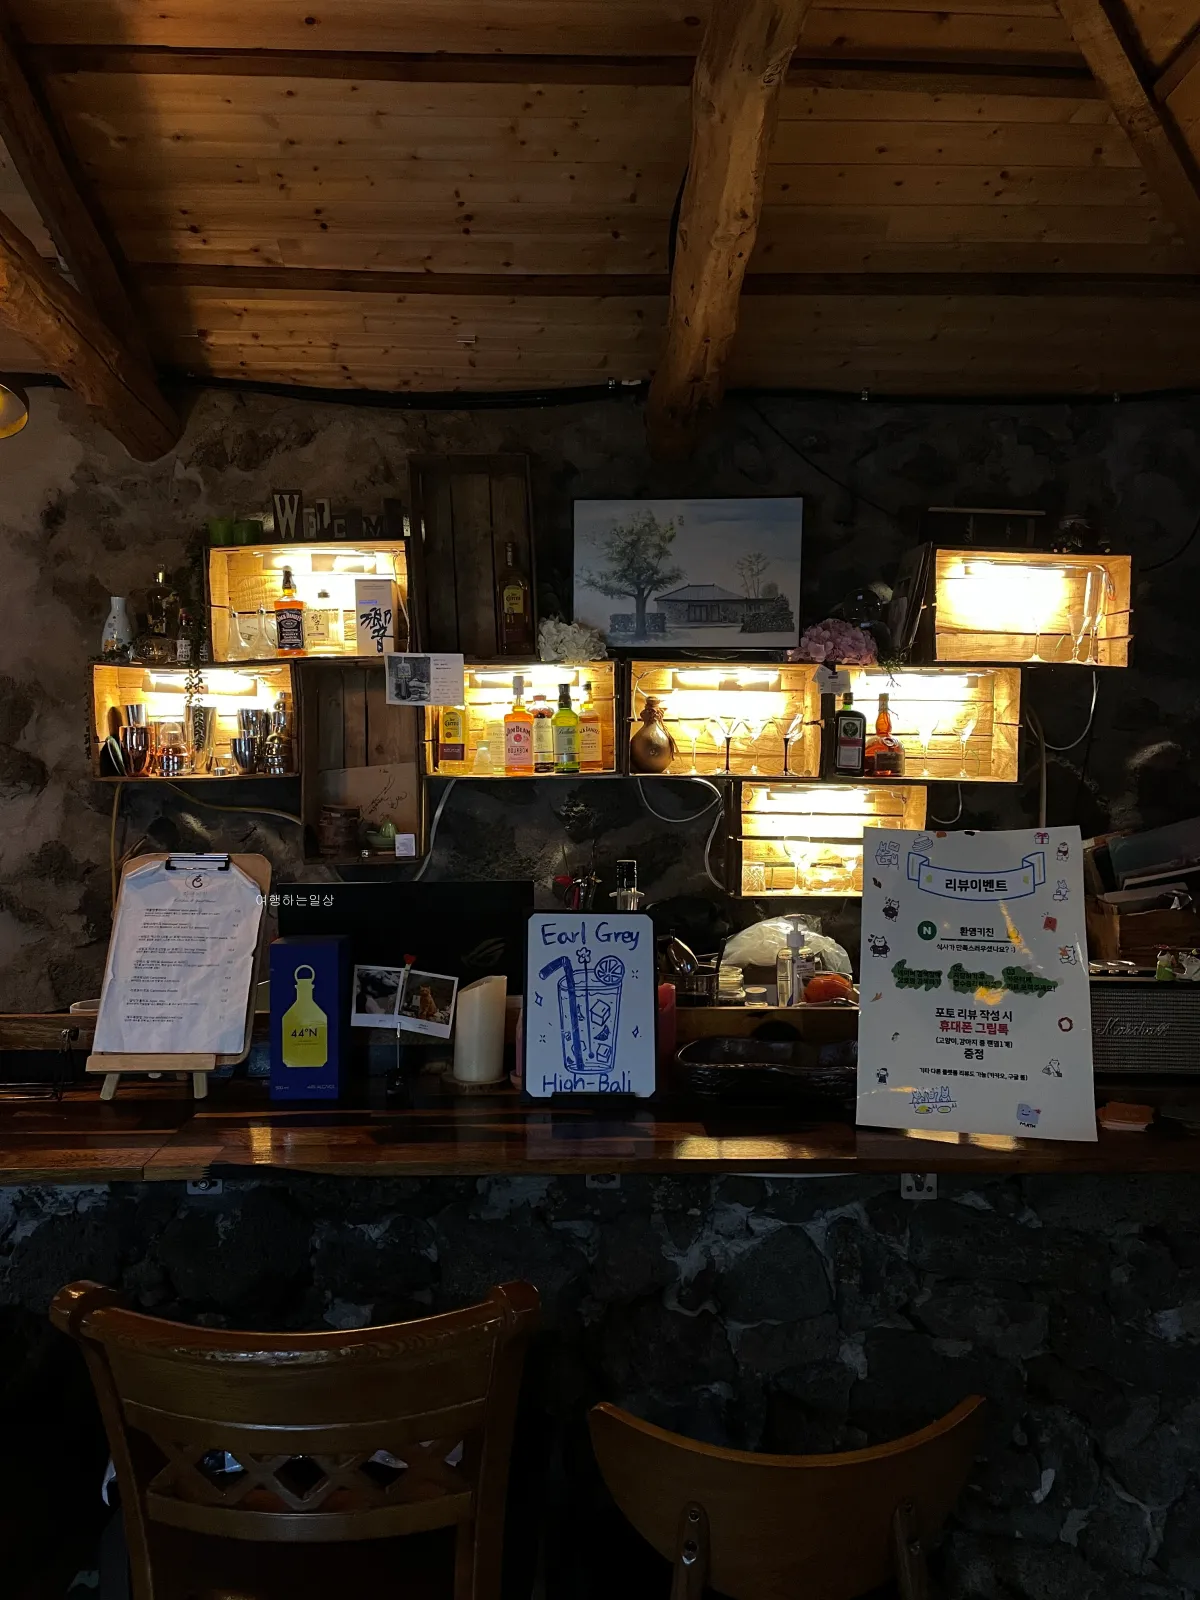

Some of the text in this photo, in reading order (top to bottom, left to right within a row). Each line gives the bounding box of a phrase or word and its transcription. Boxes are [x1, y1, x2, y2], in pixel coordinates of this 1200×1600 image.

[945, 879, 1008, 892] 리뷰이벤트
[541, 921, 640, 951] Earl Grey
[935, 1007, 1012, 1022] 포토 리뷰 작성 시
[939, 1020, 1009, 1035] 휴대폰 그립톡
[963, 1048, 984, 1060] 증정
